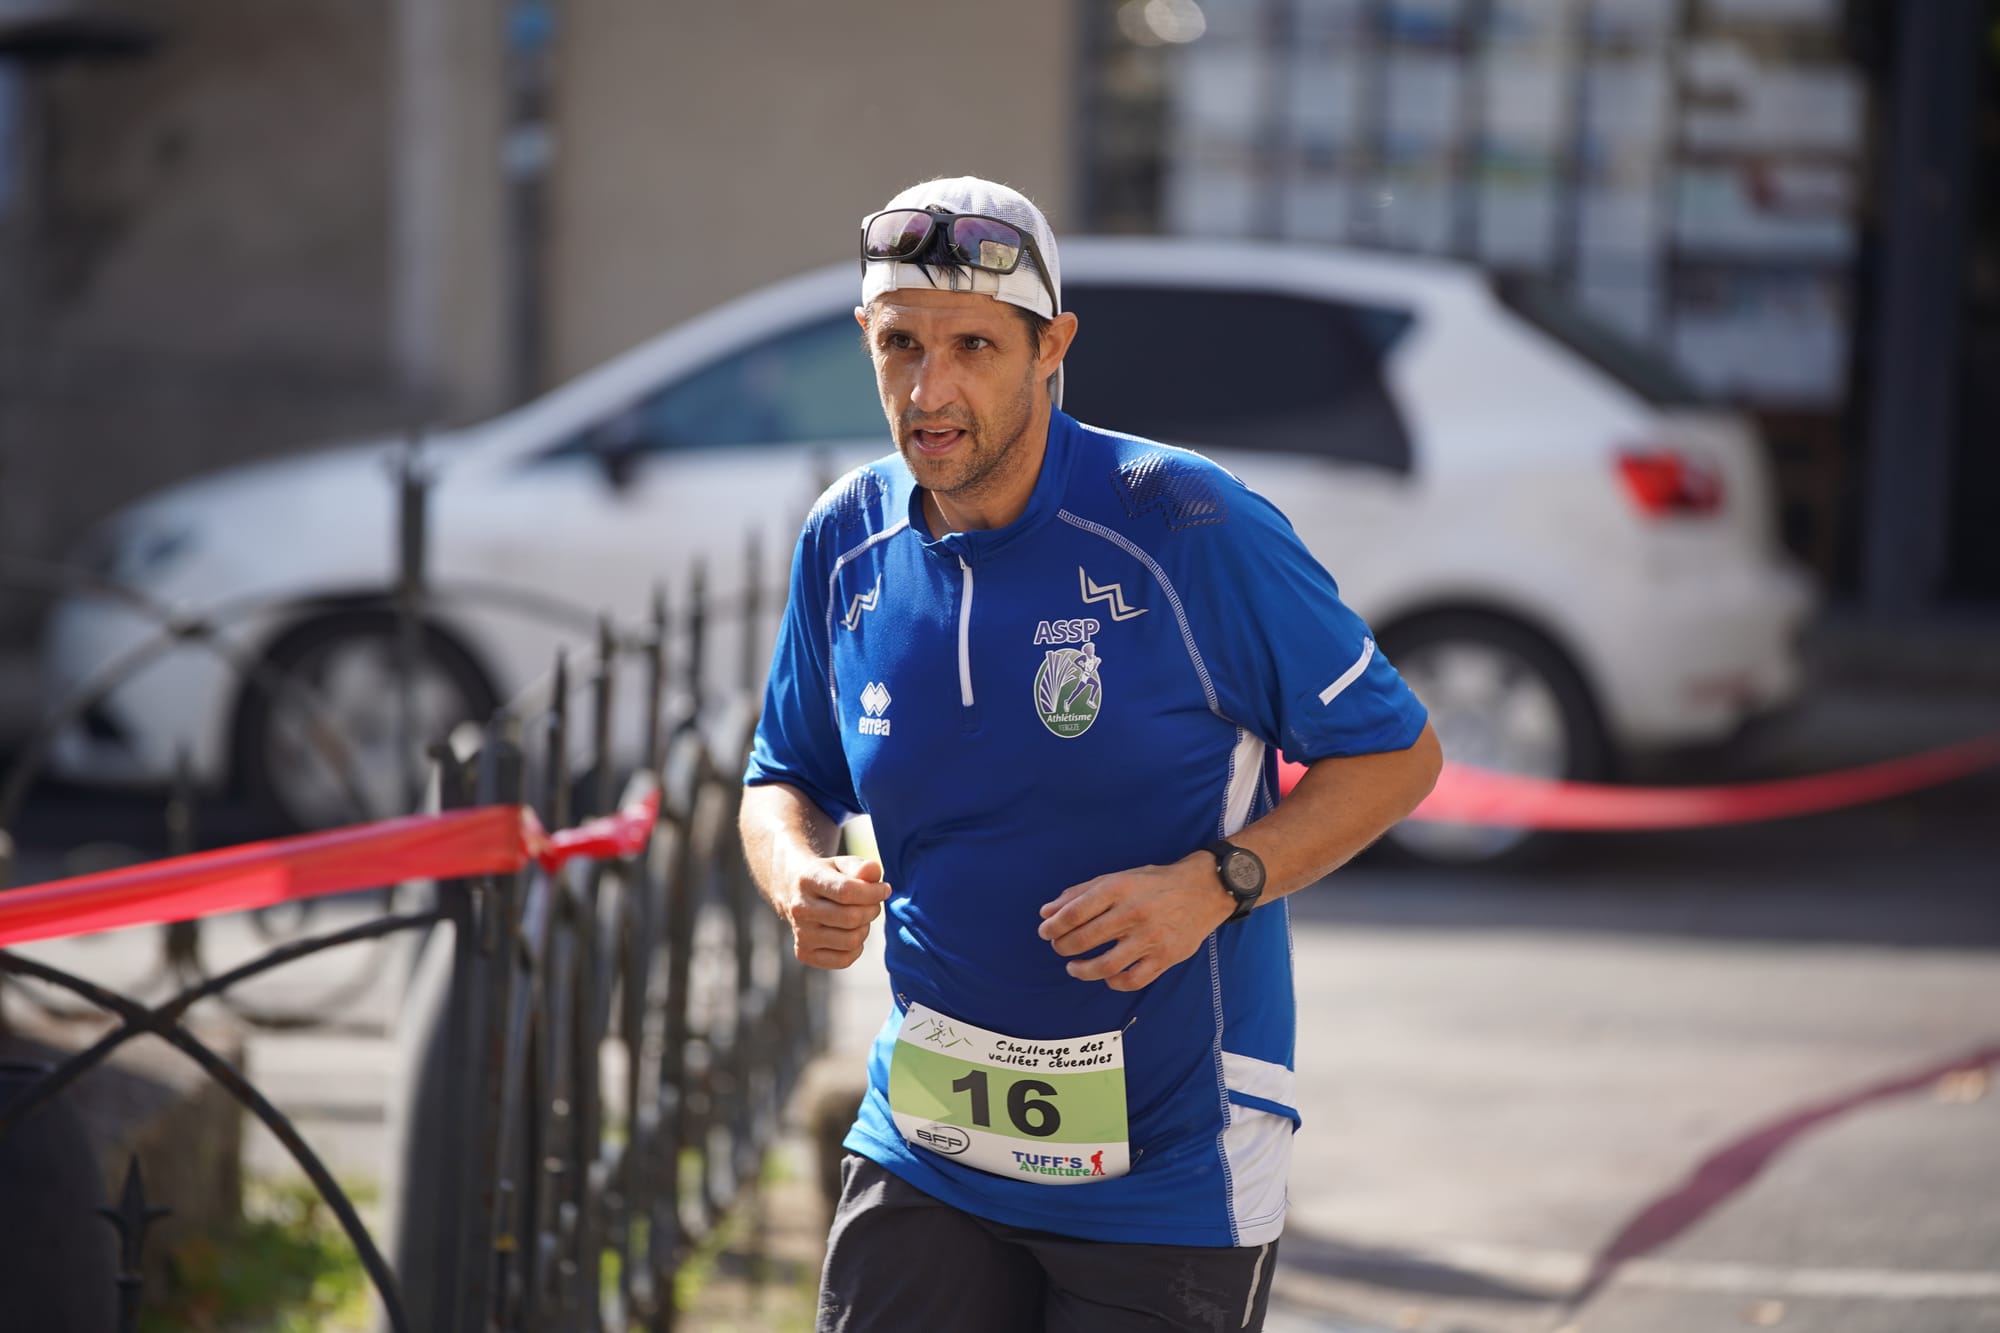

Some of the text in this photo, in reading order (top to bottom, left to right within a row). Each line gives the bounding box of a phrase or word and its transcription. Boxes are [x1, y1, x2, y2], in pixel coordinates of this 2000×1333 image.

[1033, 619, 1100, 645] ASSP
[995, 1040, 1104, 1059] Challenge des
[988, 1053, 1113, 1068] vallées cévenoles
[952, 1070, 1061, 1137] 16
[916, 1129, 962, 1147] BFP
[1012, 1151, 1083, 1169] TUFF'S
[1019, 1160, 1091, 1177] Aventure
